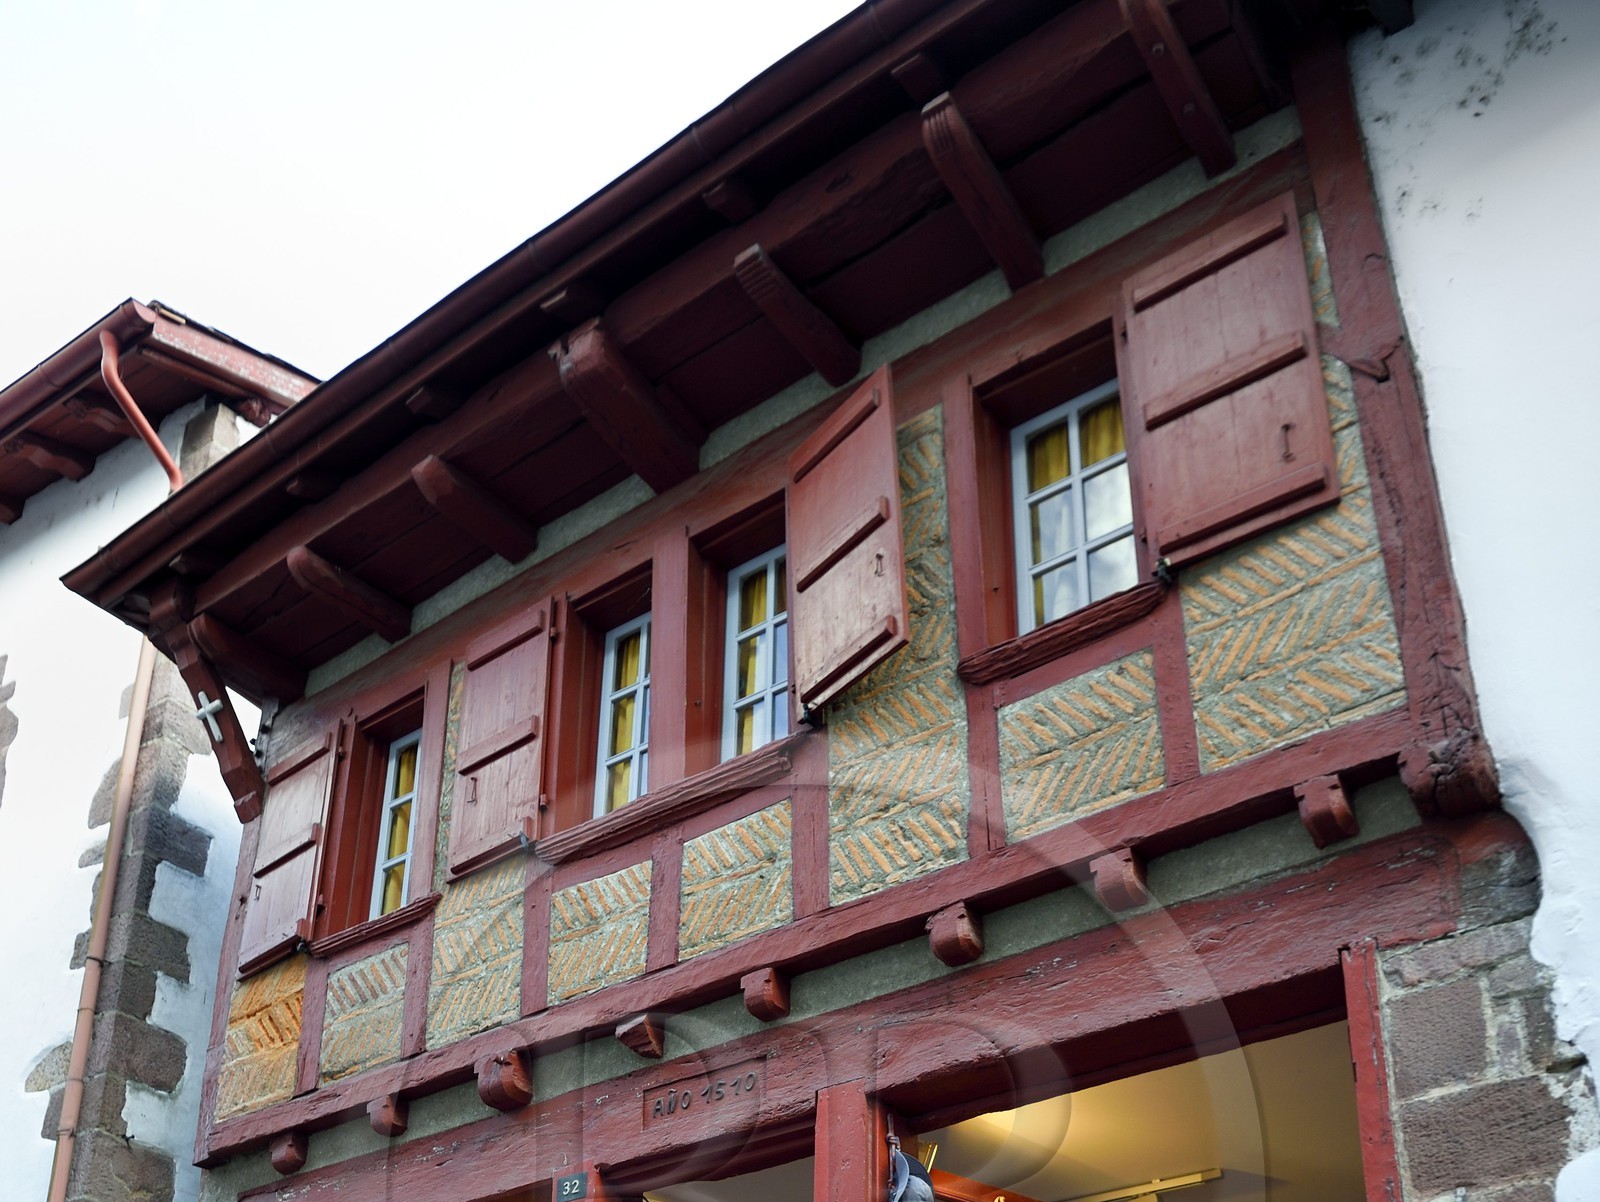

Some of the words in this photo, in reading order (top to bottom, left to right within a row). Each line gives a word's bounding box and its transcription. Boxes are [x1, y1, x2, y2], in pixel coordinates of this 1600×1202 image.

[652, 1088, 691, 1118] AÑO
[701, 1071, 756, 1104] 1510
[562, 1179, 580, 1196] 32
